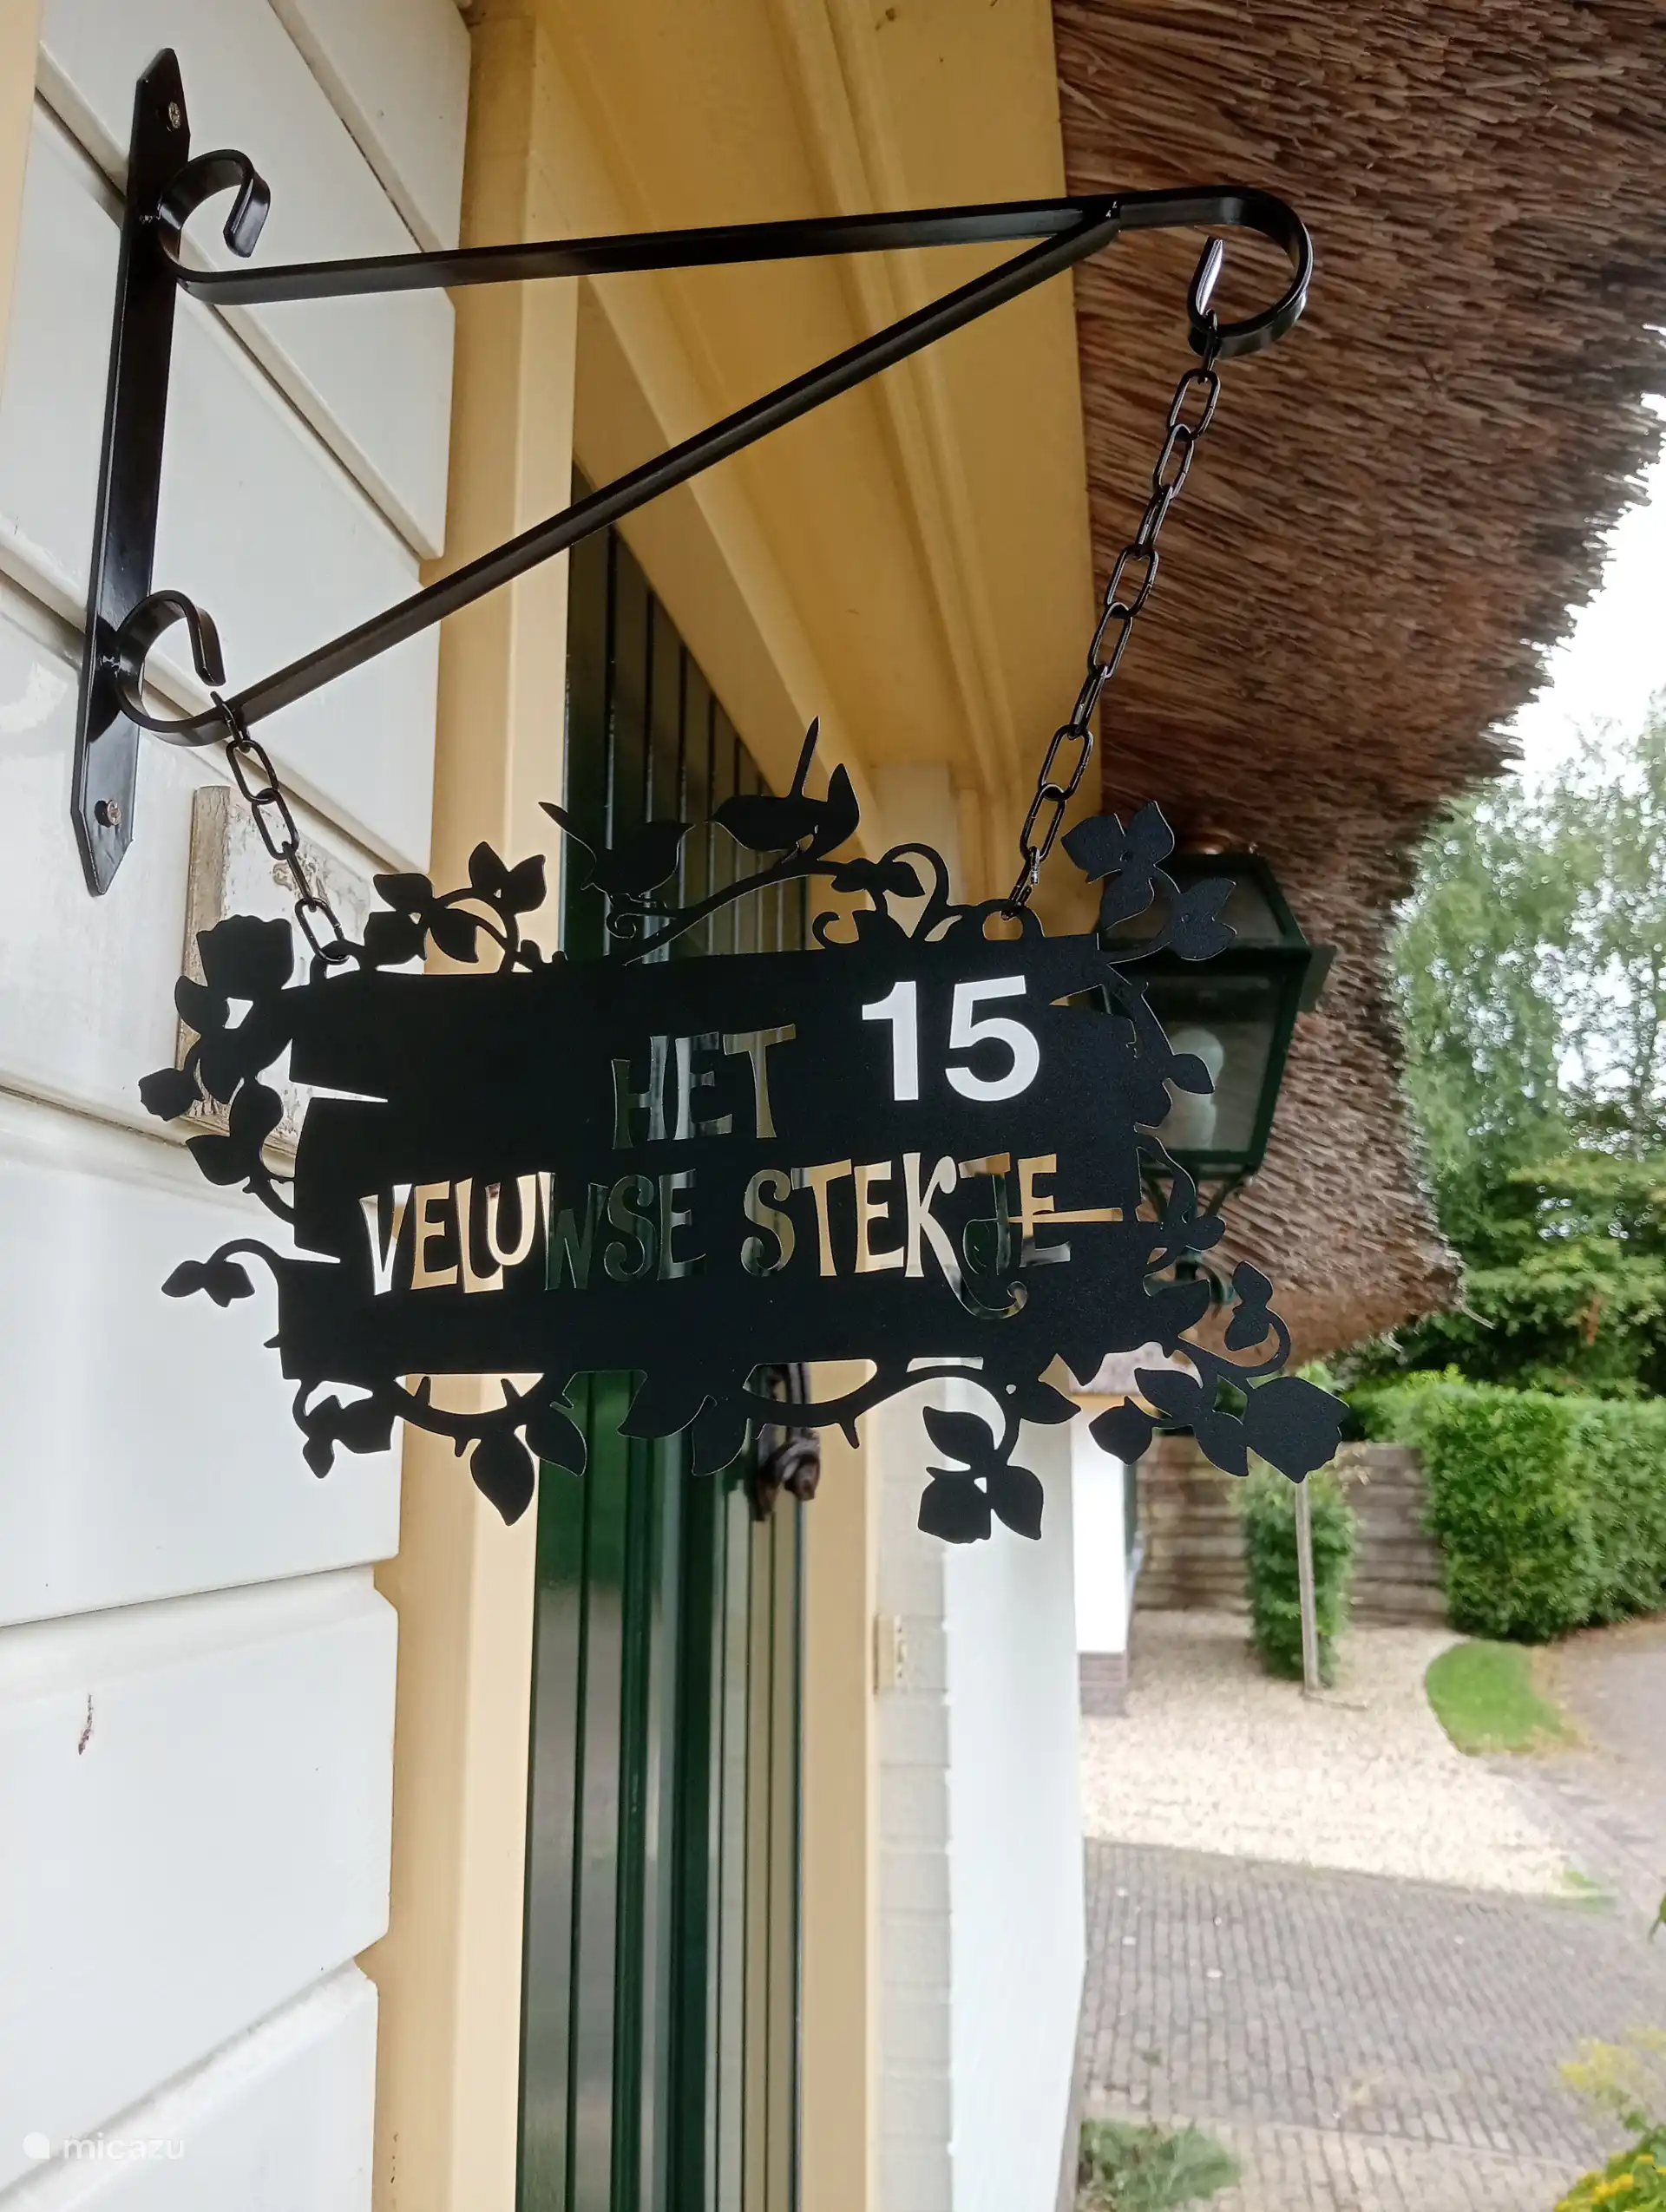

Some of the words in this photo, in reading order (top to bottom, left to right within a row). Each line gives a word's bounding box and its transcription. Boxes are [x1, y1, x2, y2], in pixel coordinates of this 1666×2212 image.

[611, 1023, 797, 1151] HET
[862, 974, 1041, 1103] 15
[358, 1168, 707, 1295] VELUWSE
[740, 1150, 1124, 1319] STEKJE
